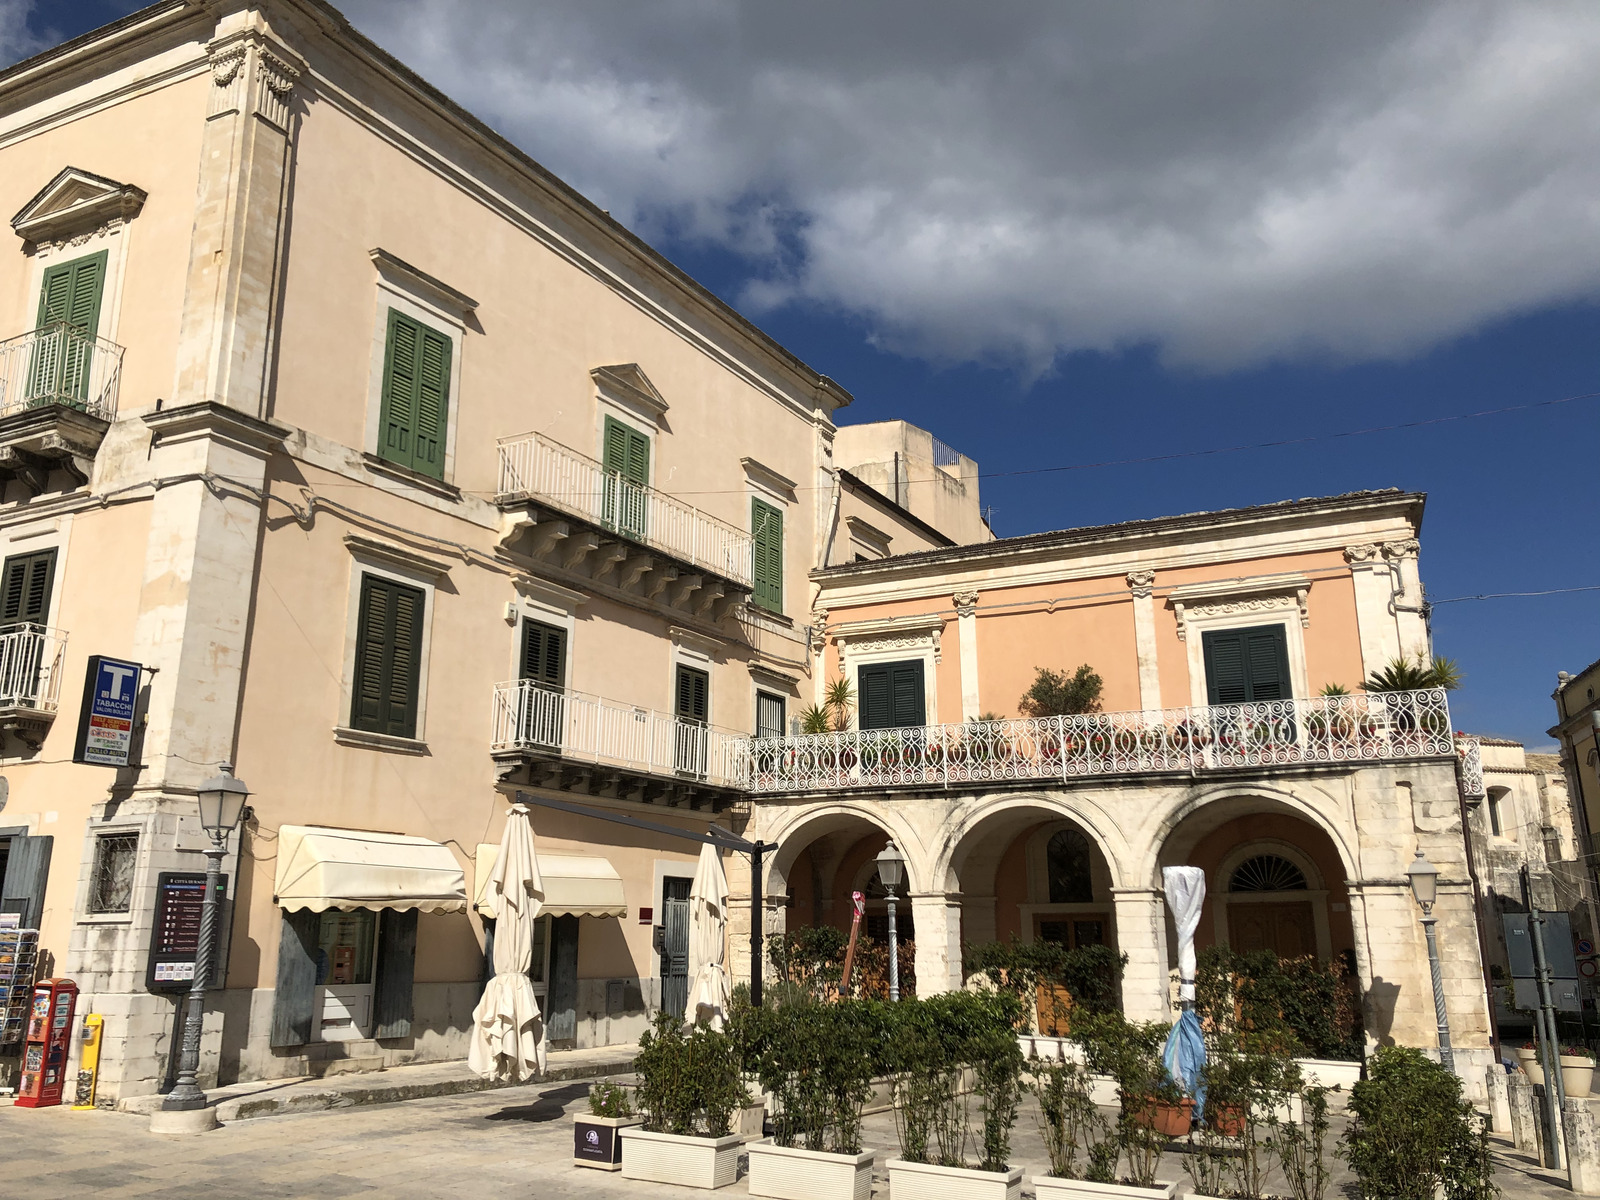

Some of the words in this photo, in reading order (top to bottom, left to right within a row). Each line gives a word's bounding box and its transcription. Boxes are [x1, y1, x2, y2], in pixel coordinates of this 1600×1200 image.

[103, 664, 133, 700] T
[96, 699, 132, 711] TABACCHI
[107, 718, 129, 726] SERVICE
[88, 747, 108, 755] BOLLO
